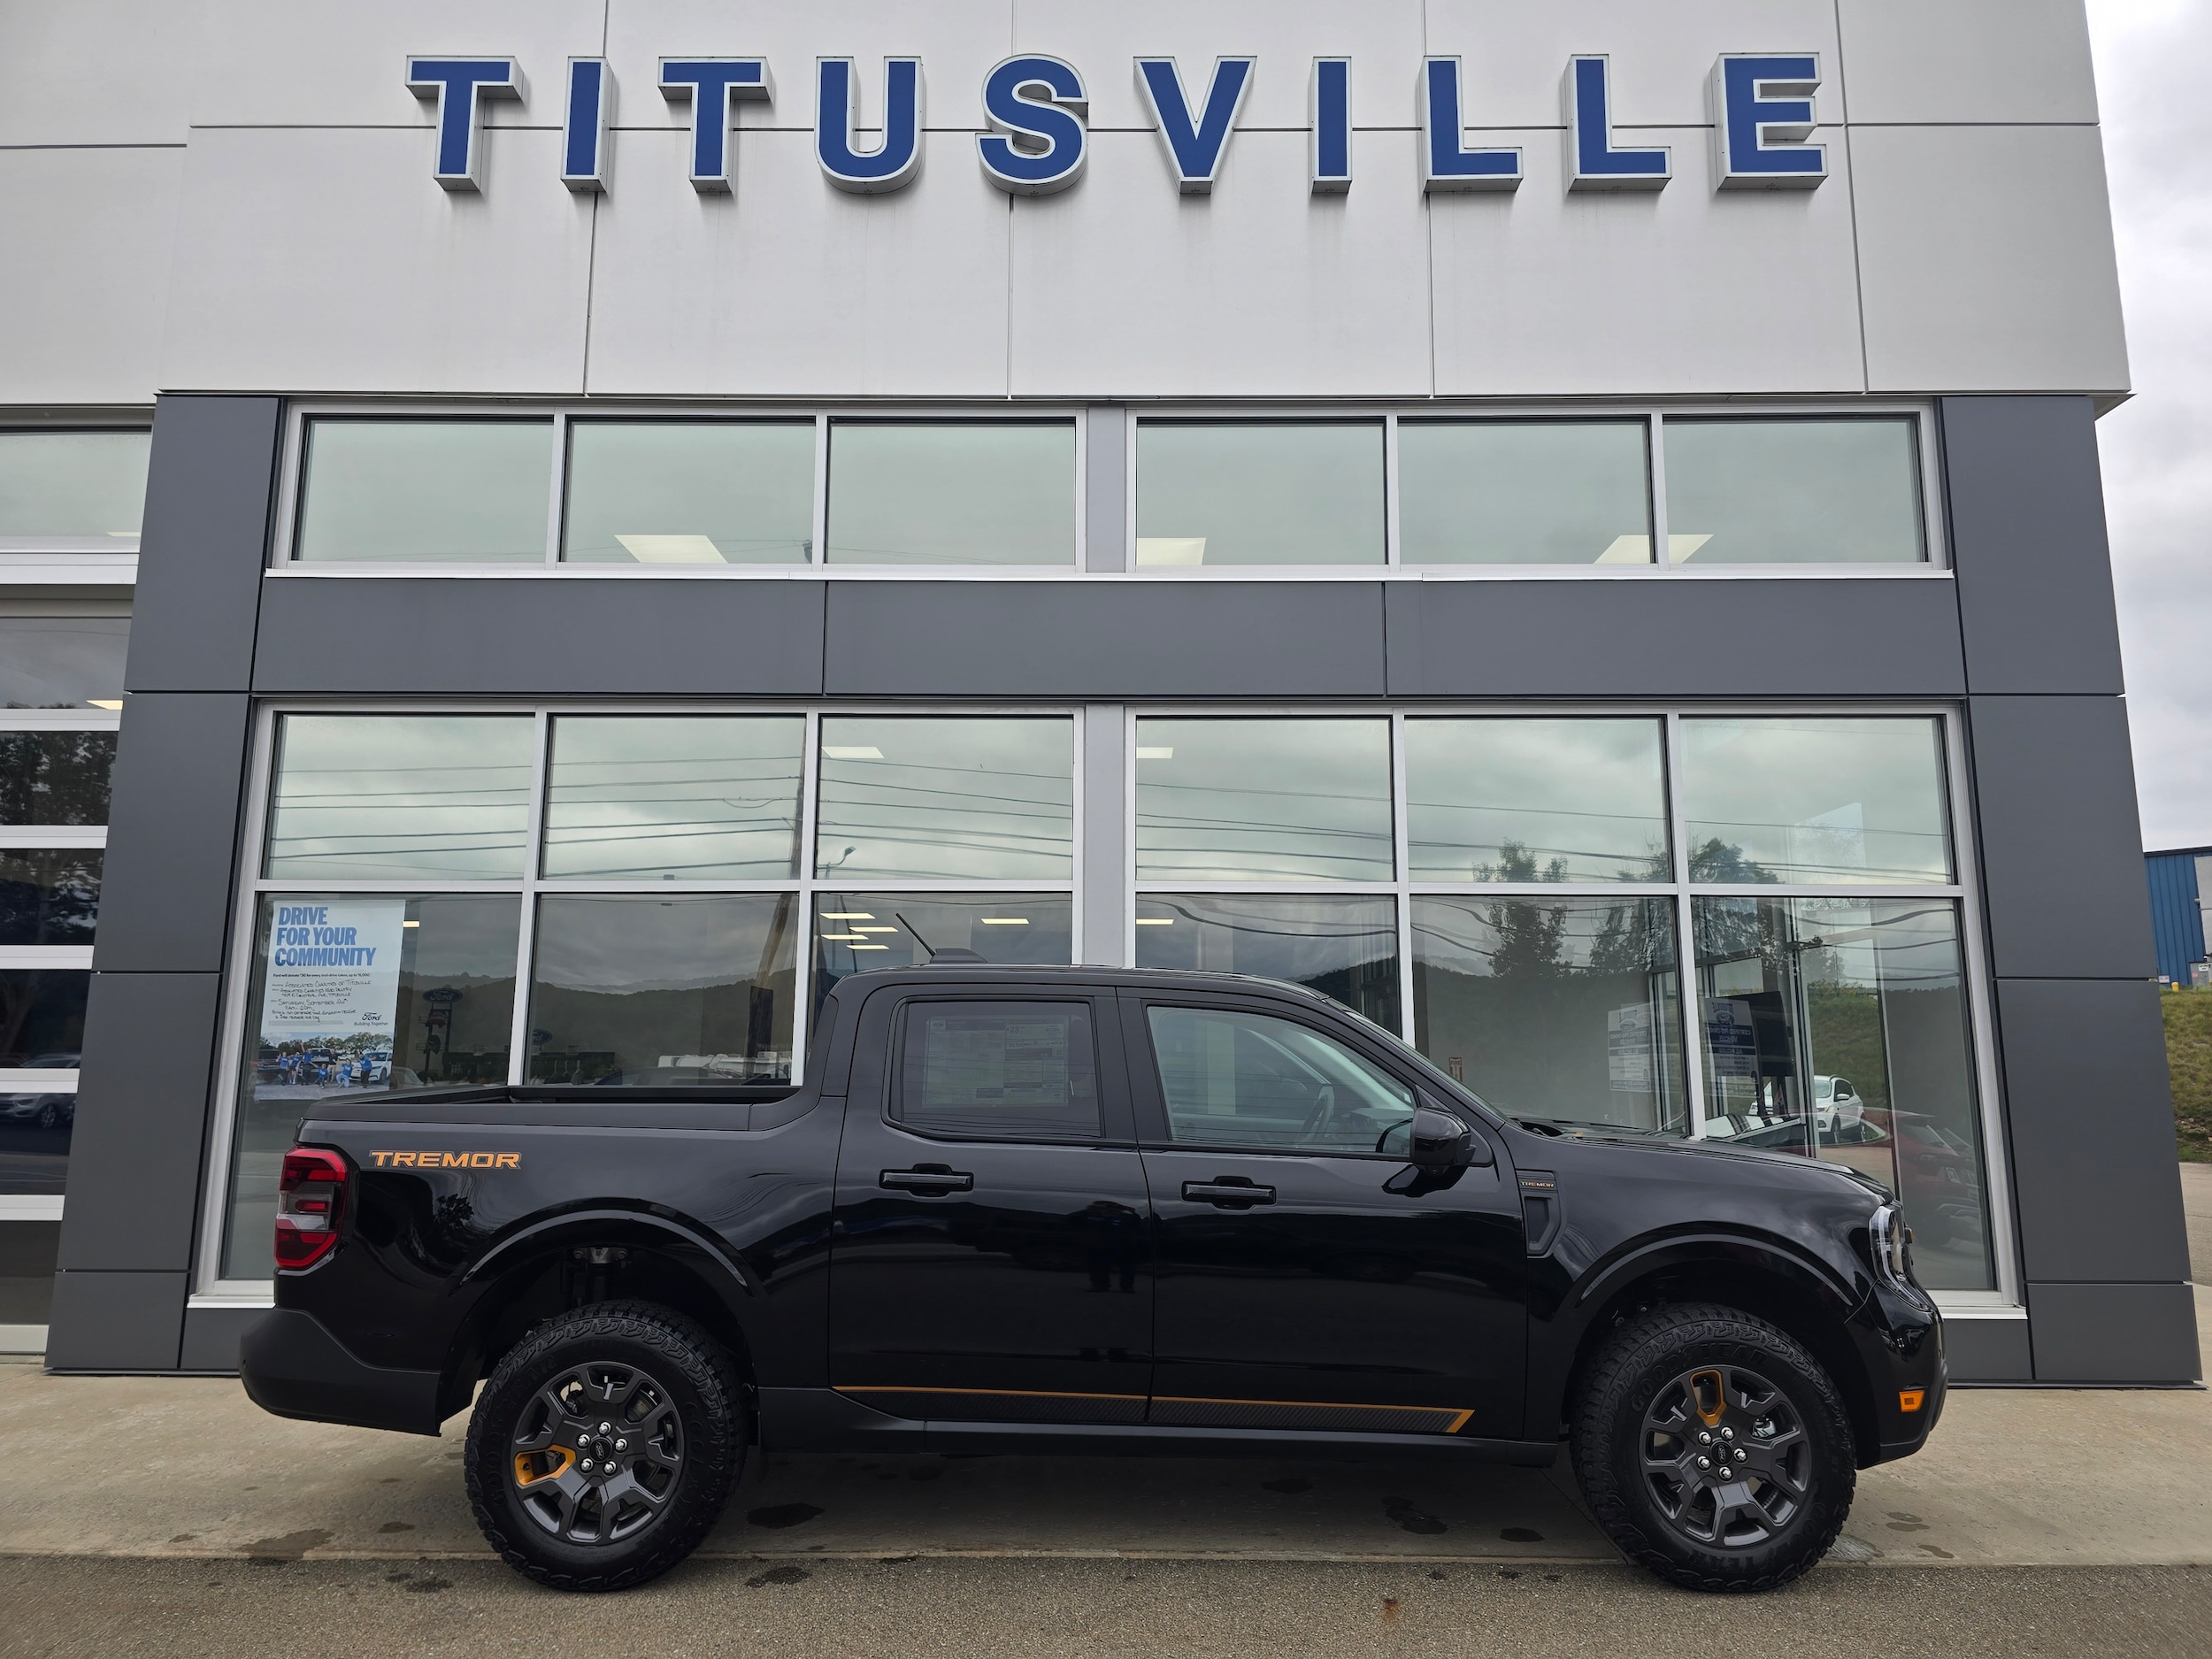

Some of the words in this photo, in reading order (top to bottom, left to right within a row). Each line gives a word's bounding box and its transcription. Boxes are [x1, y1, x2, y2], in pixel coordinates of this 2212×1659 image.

[405, 53, 1828, 194] TITUSVILLE
[278, 906, 328, 926] DRIVE
[276, 927, 311, 946] FOR
[312, 926, 357, 946] YOUR
[274, 947, 377, 966] COMMUNITY
[430, 990, 454, 1001] Ford
[362, 1012, 382, 1021] Ford
[370, 1151, 521, 1169] TREMOR
